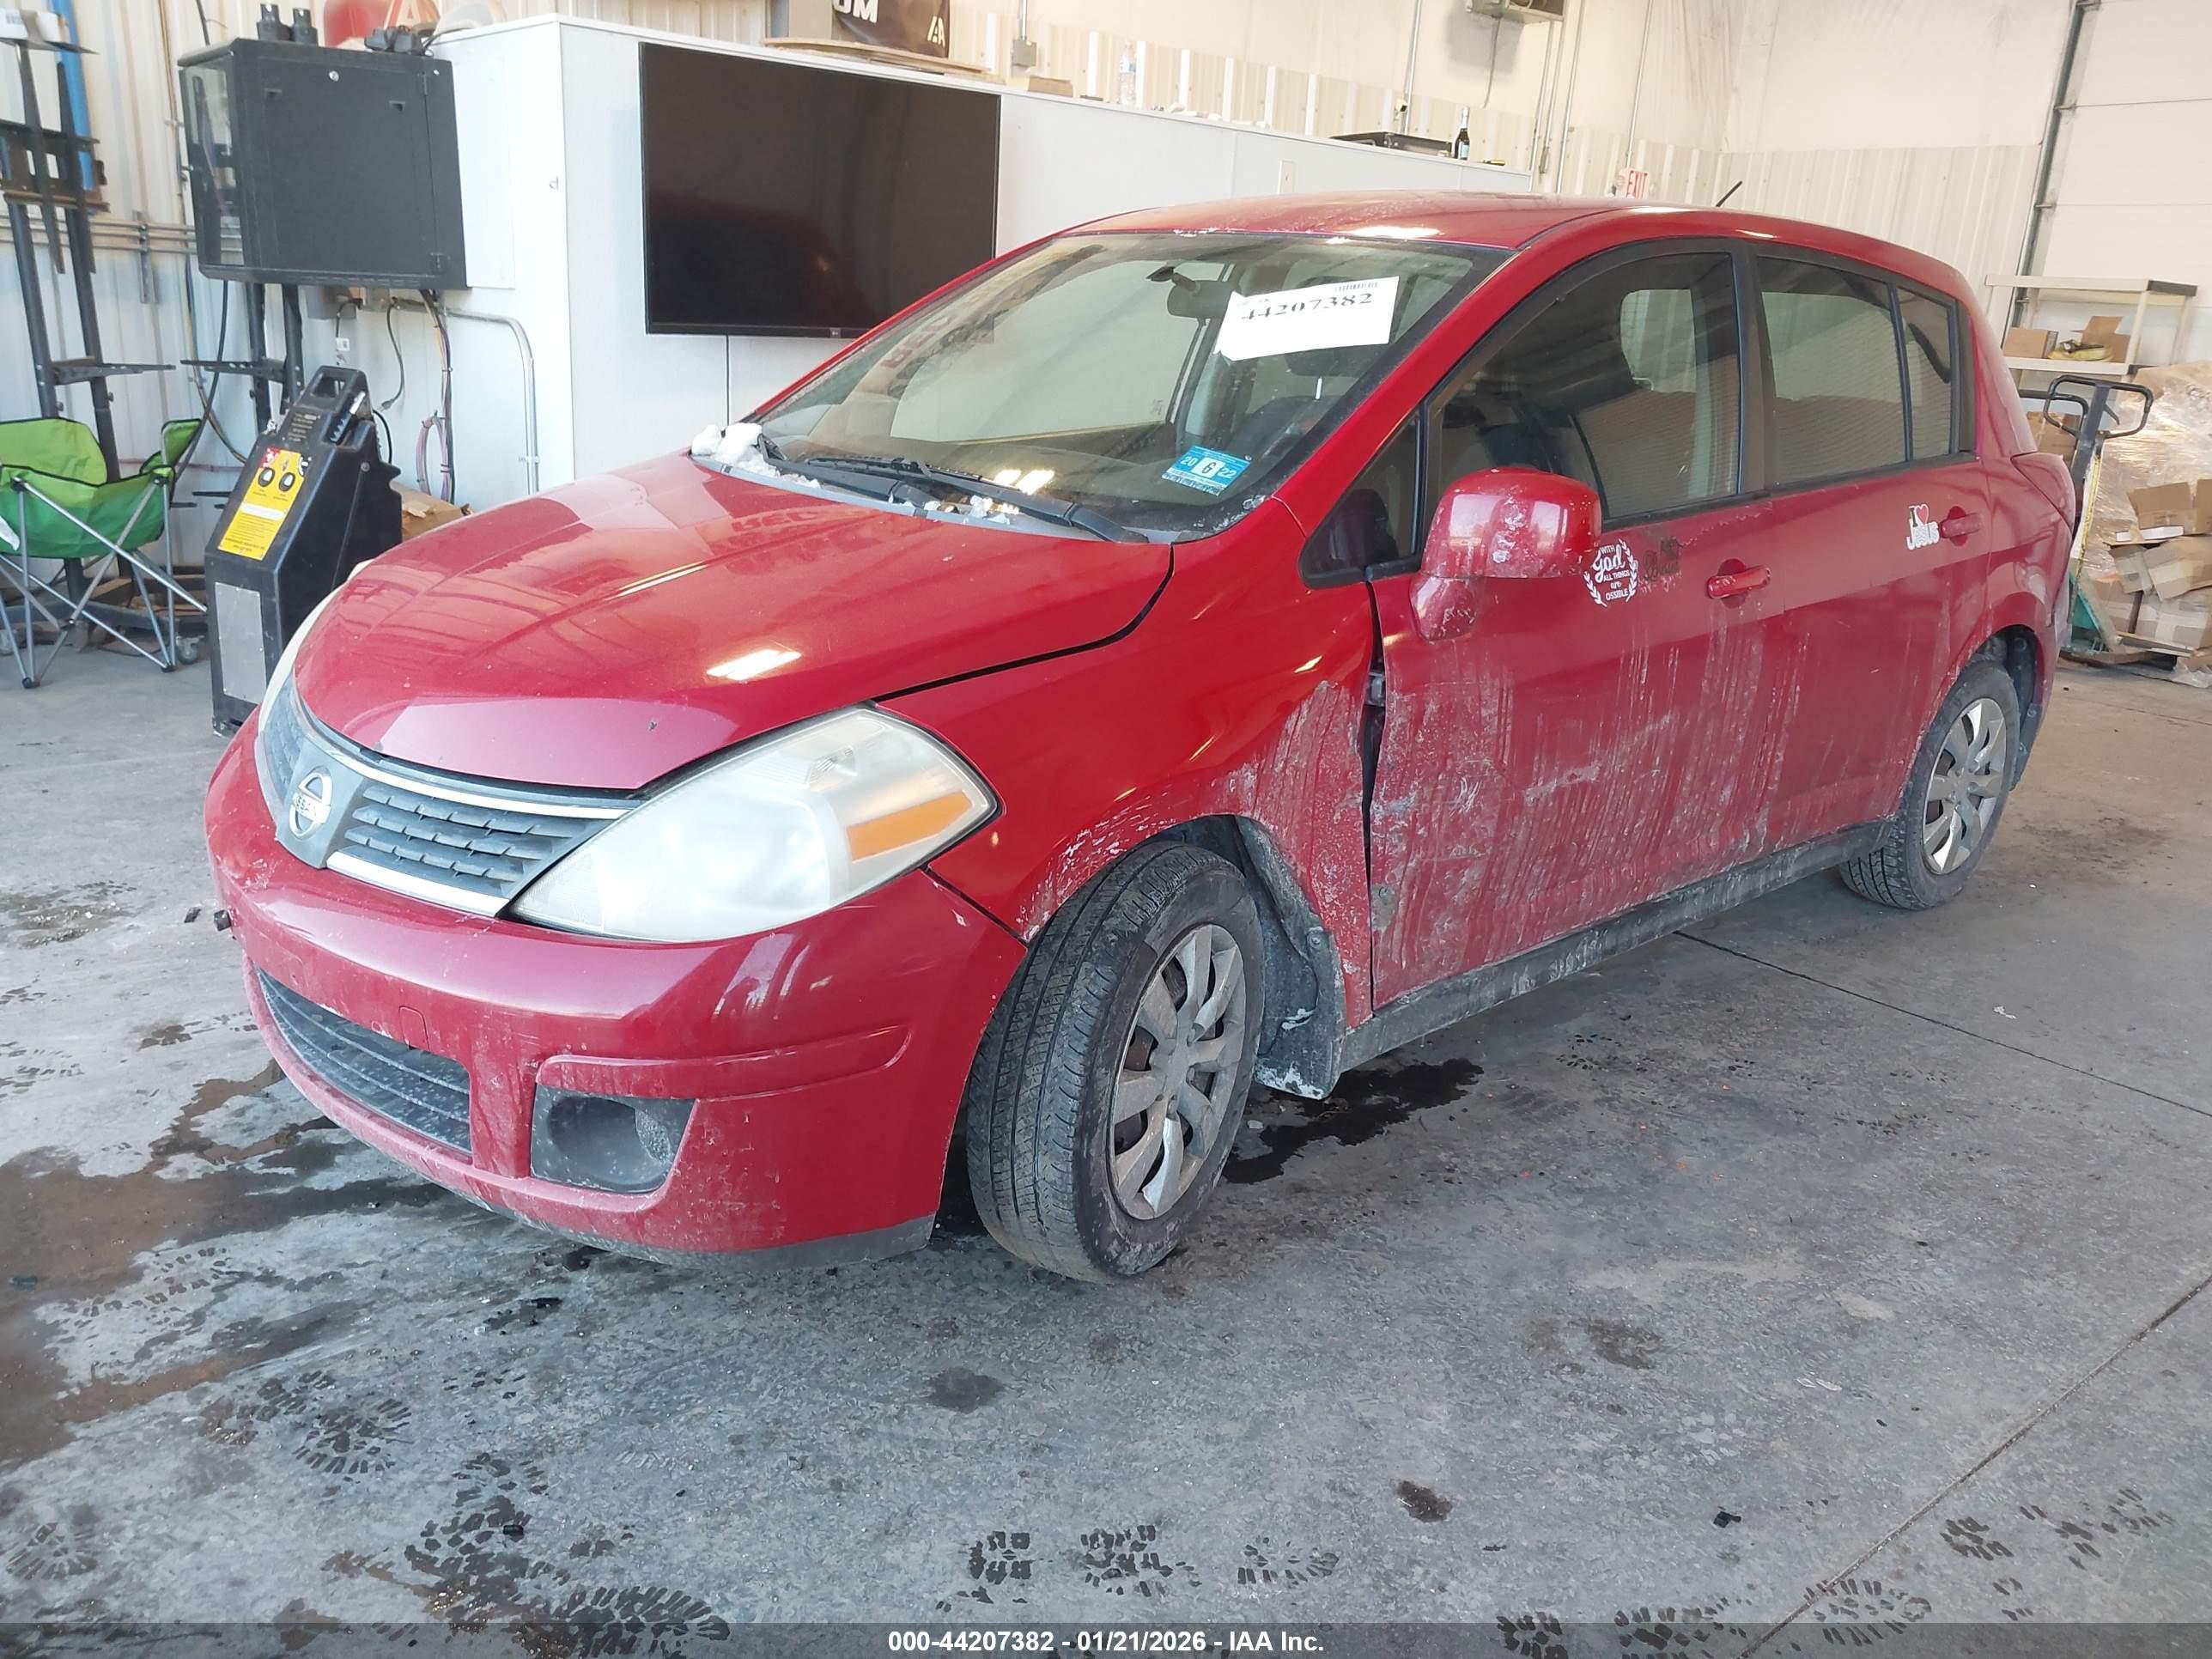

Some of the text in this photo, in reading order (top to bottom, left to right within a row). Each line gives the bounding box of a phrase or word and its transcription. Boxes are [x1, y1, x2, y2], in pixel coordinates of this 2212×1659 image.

[1626, 170, 1648, 199] EXIT
[1241, 292, 1373, 320] 44207382
[1180, 456, 1199, 467] 20
[1217, 466, 1237, 479] 22
[1599, 544, 1615, 555] WITH
[1603, 569, 1630, 582] ALL THINGS
